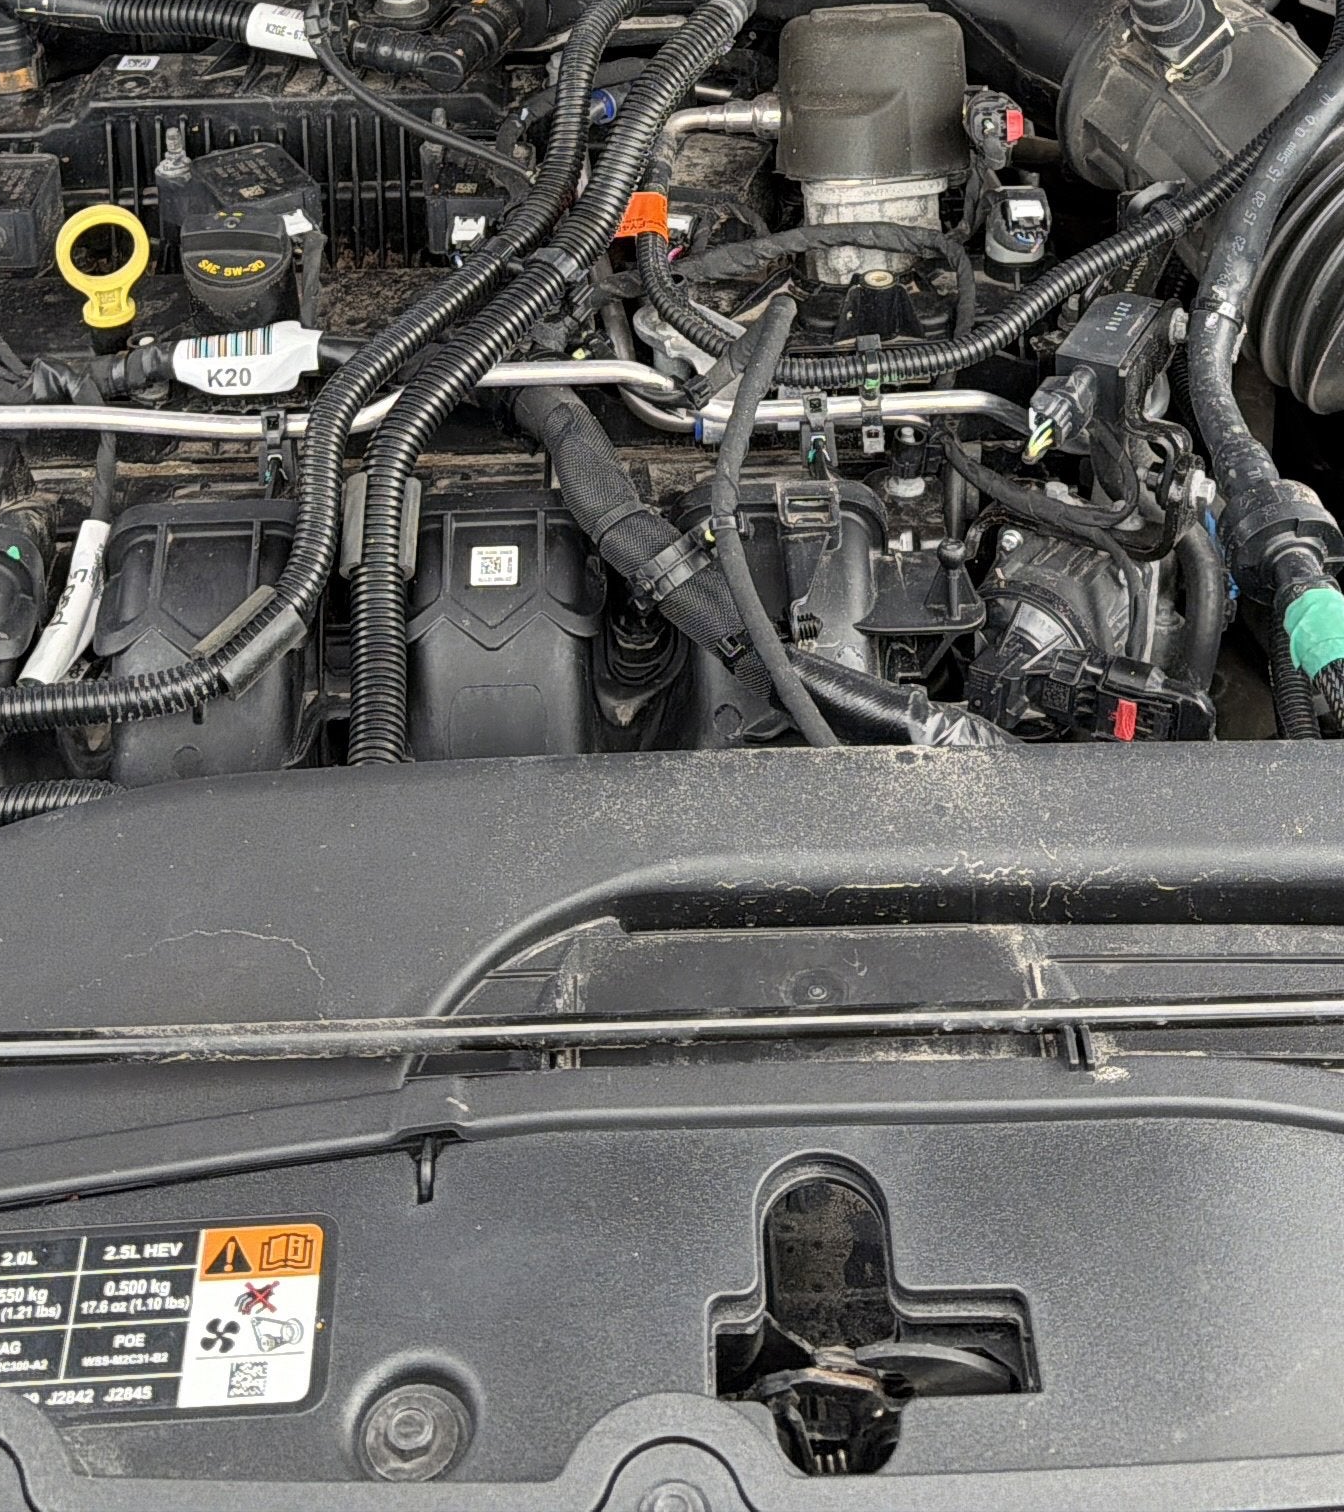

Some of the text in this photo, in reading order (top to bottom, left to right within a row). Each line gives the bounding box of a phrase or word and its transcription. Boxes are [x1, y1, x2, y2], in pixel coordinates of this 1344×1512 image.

[198, 259, 266, 277] SAE 5W-30
[206, 366, 252, 389] K20
[0, 1251, 38, 1267] 2.0L
[102, 1241, 183, 1261] 2.5L HEV
[26, 1286, 49, 1305] kg
[103, 1278, 171, 1296] 0.500 kg
[0, 1306, 33, 1323] (1.21
[34, 1303, 63, 1321] lbs)
[80, 1295, 192, 1315] 17.6 oz (1.10 lbs)
[113, 1332, 146, 1348] POE
[45, 1388, 95, 1406] J2842
[103, 1385, 153, 1402] J2845
